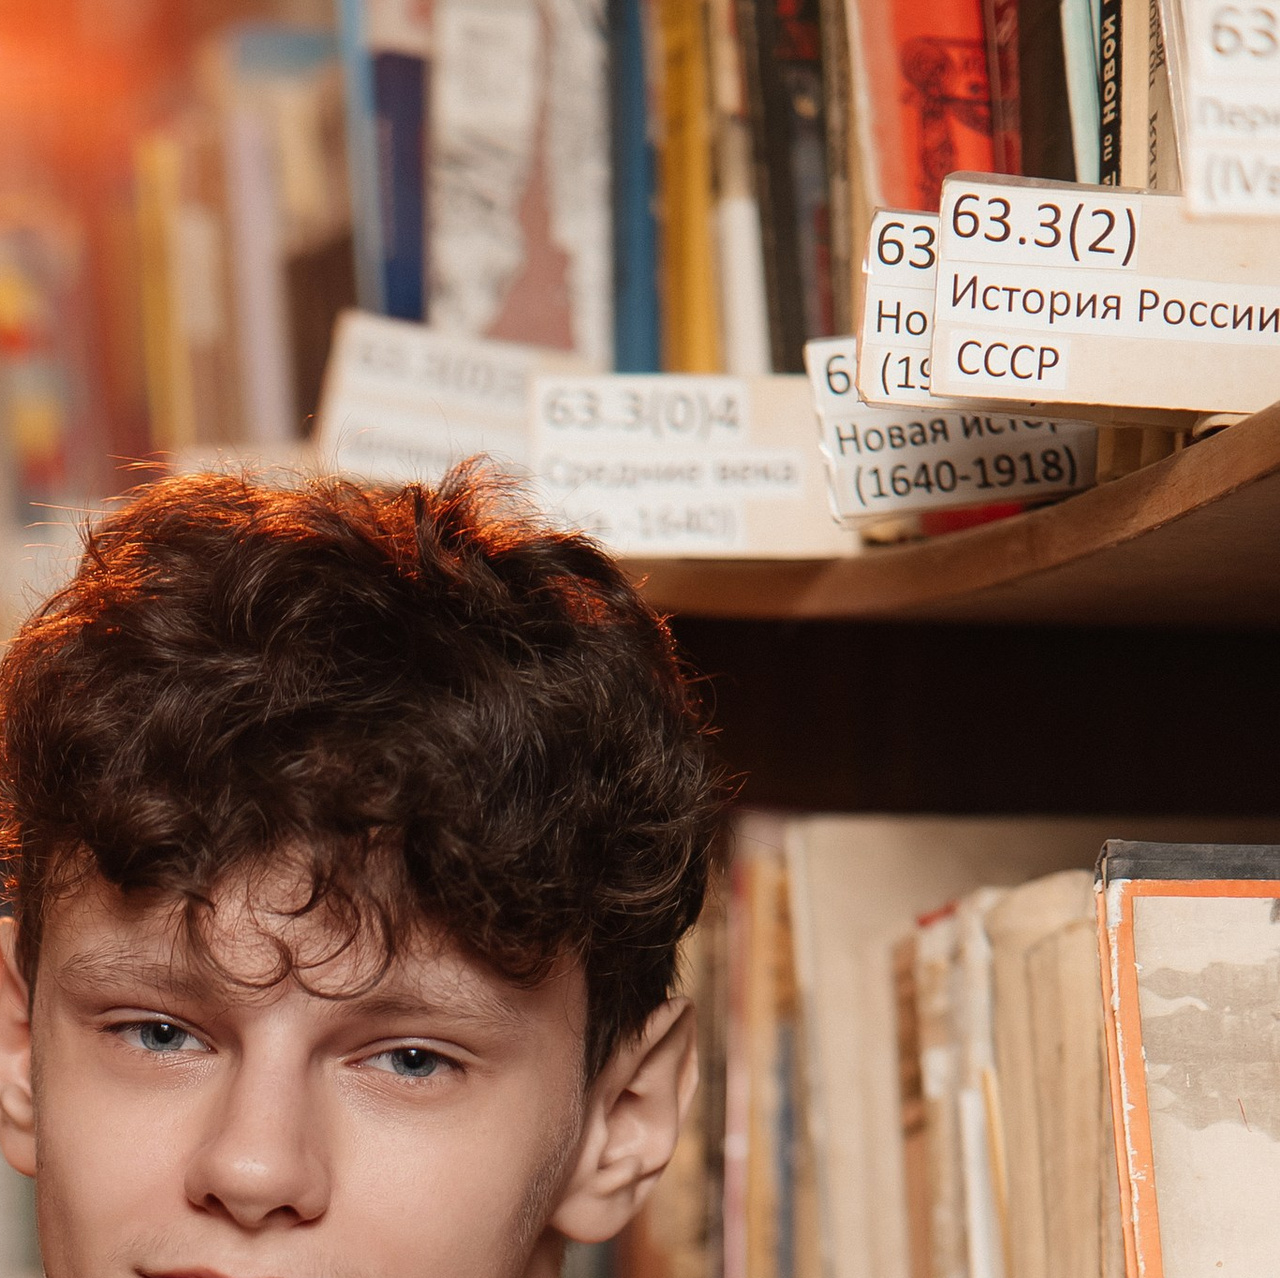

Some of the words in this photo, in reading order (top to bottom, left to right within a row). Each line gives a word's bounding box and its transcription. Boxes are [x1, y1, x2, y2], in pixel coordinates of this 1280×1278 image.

[1102, 14, 1117, 125] НОВОЙ
[951, 194, 1138, 267] 63.3(2)
[950, 273, 1122, 324] История
[1138, 289, 1280, 333] России
[956, 340, 1061, 381] СССР
[835, 418, 951, 456] Новая
[854, 444, 1078, 507] (1640-1918)
